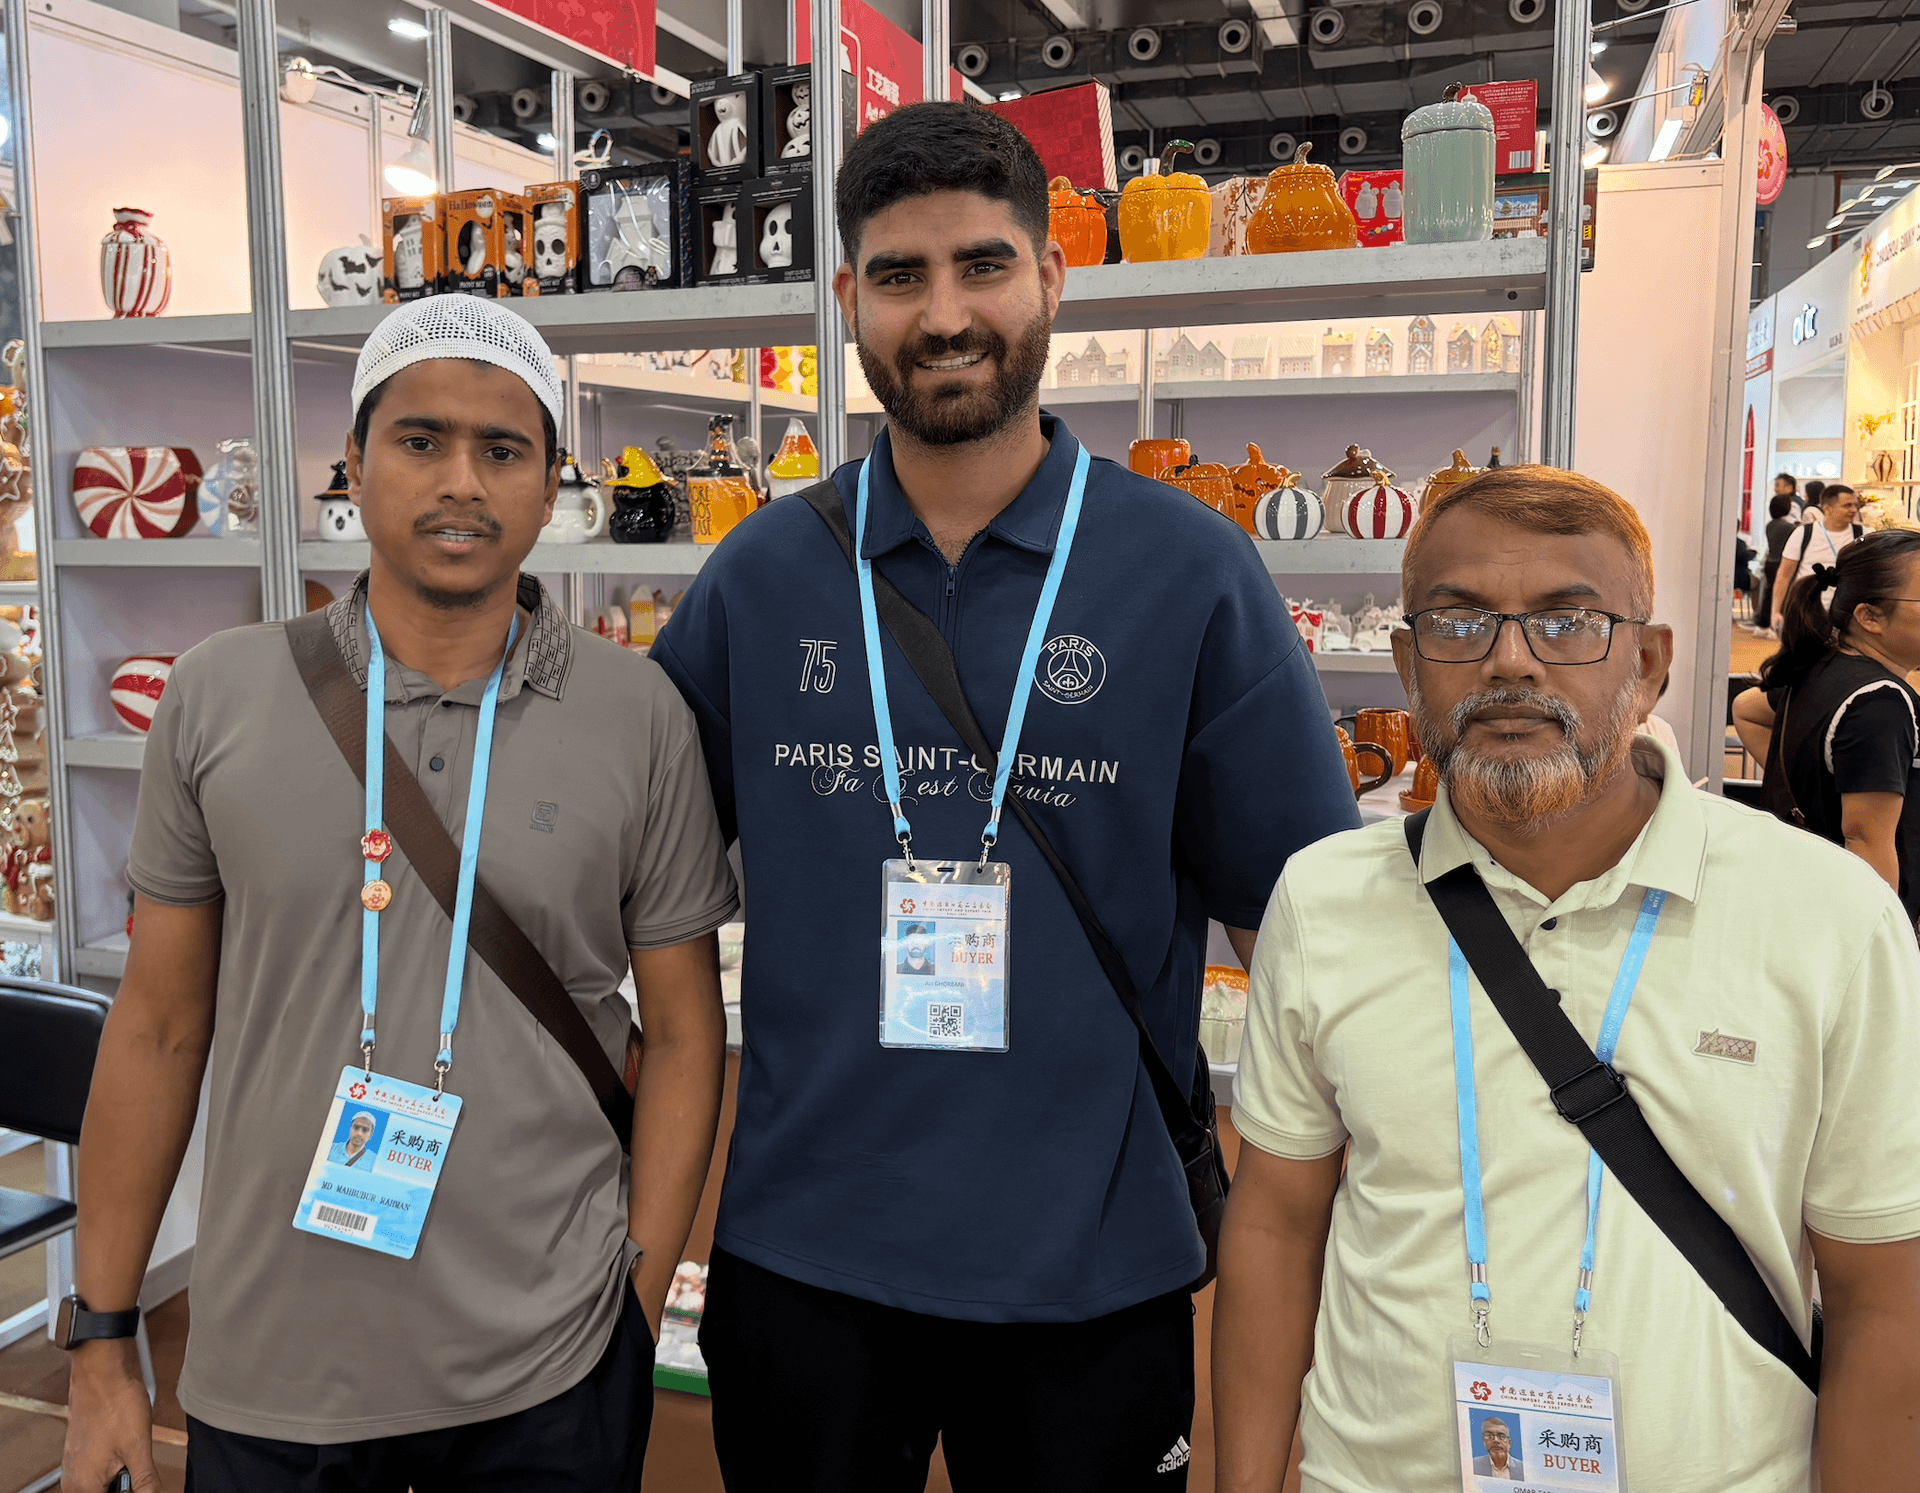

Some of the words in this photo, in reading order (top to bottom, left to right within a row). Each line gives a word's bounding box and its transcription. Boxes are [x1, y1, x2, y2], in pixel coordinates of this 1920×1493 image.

[1047, 638, 1095, 657] PARIS
[799, 639, 838, 693] 75
[774, 743, 854, 767] PARIS
[389, 1129, 443, 1157] 采购商
[386, 1149, 433, 1173] BUYER
[321, 1181, 333, 1190] MD
[1537, 1428, 1604, 1455] 采购商
[1156, 1449, 1191, 1473] adida
[1543, 1453, 1603, 1475] BUYER
